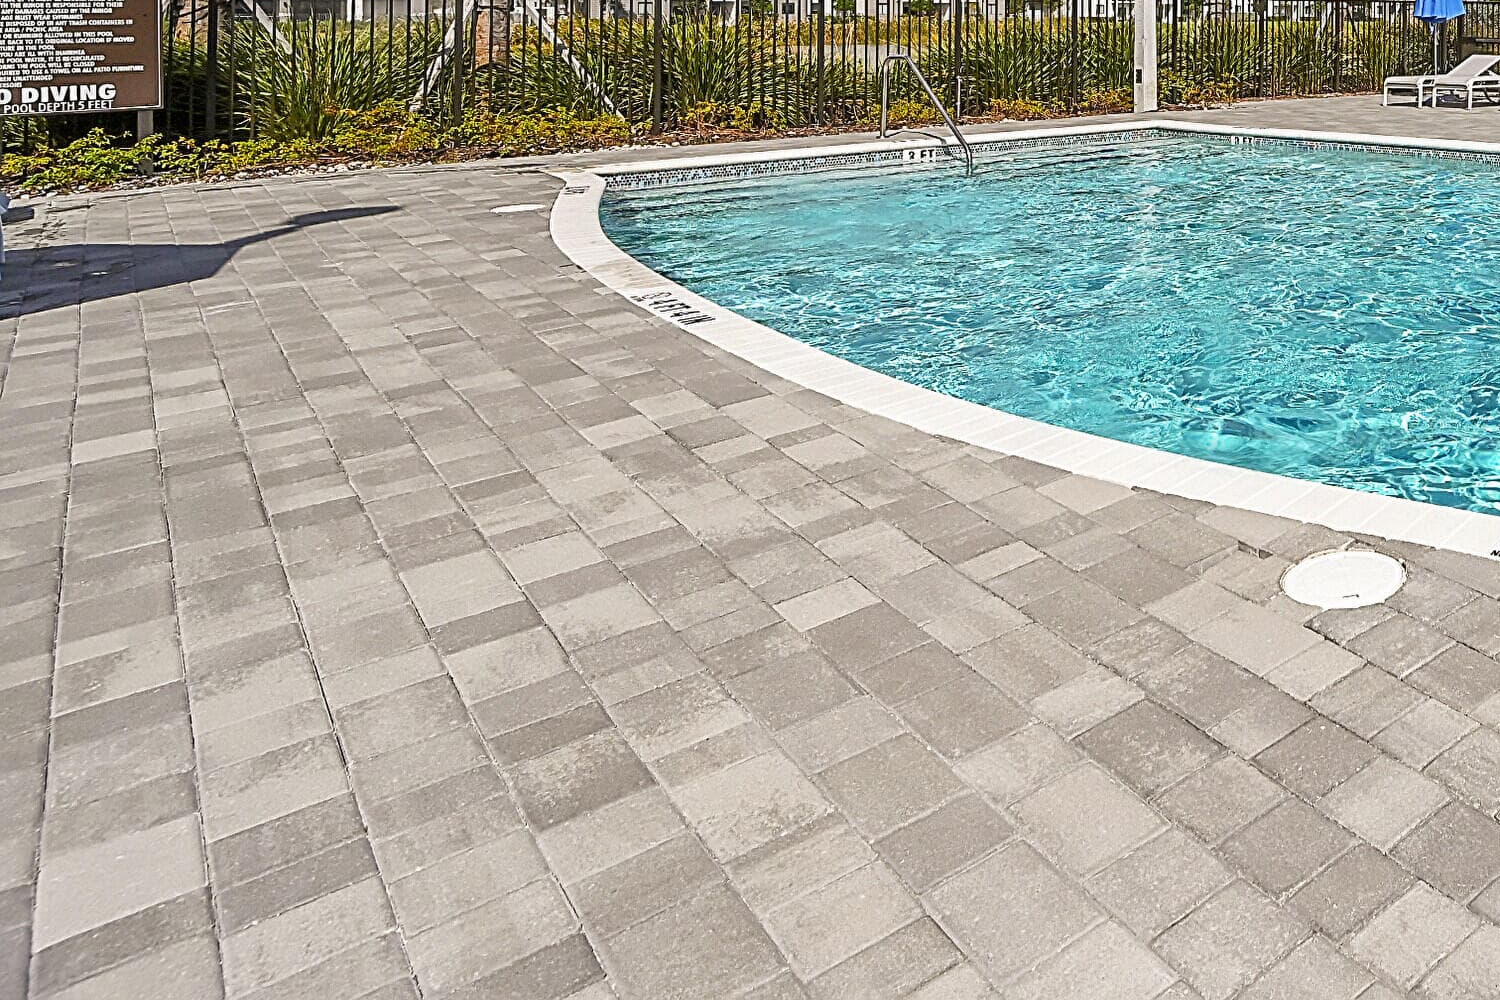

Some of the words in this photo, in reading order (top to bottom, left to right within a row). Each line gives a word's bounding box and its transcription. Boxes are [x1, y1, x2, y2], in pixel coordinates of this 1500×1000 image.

[21, 83, 117, 104] DIVING
[3, 103, 35, 114] POOL
[38, 101, 75, 112] DEPTH
[78, 100, 86, 110] 5
[87, 99, 114, 110] FEET
[920, 149, 935, 159] FT
